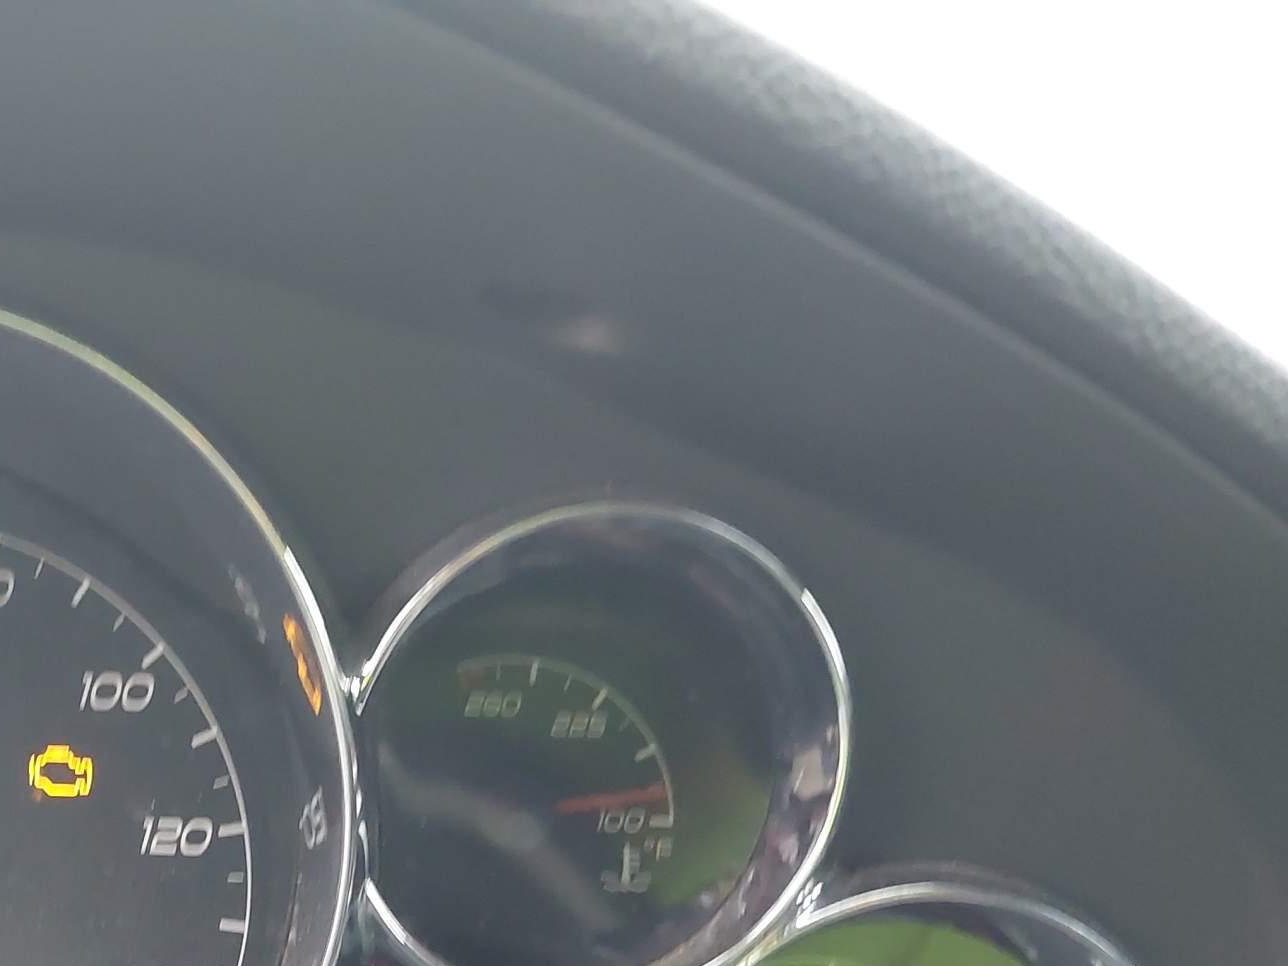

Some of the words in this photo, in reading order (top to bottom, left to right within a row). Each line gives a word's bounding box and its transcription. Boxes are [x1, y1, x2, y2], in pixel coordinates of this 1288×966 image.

[80, 671, 155, 712] 100
[140, 816, 213, 857] 120
[597, 807, 646, 833] 100
